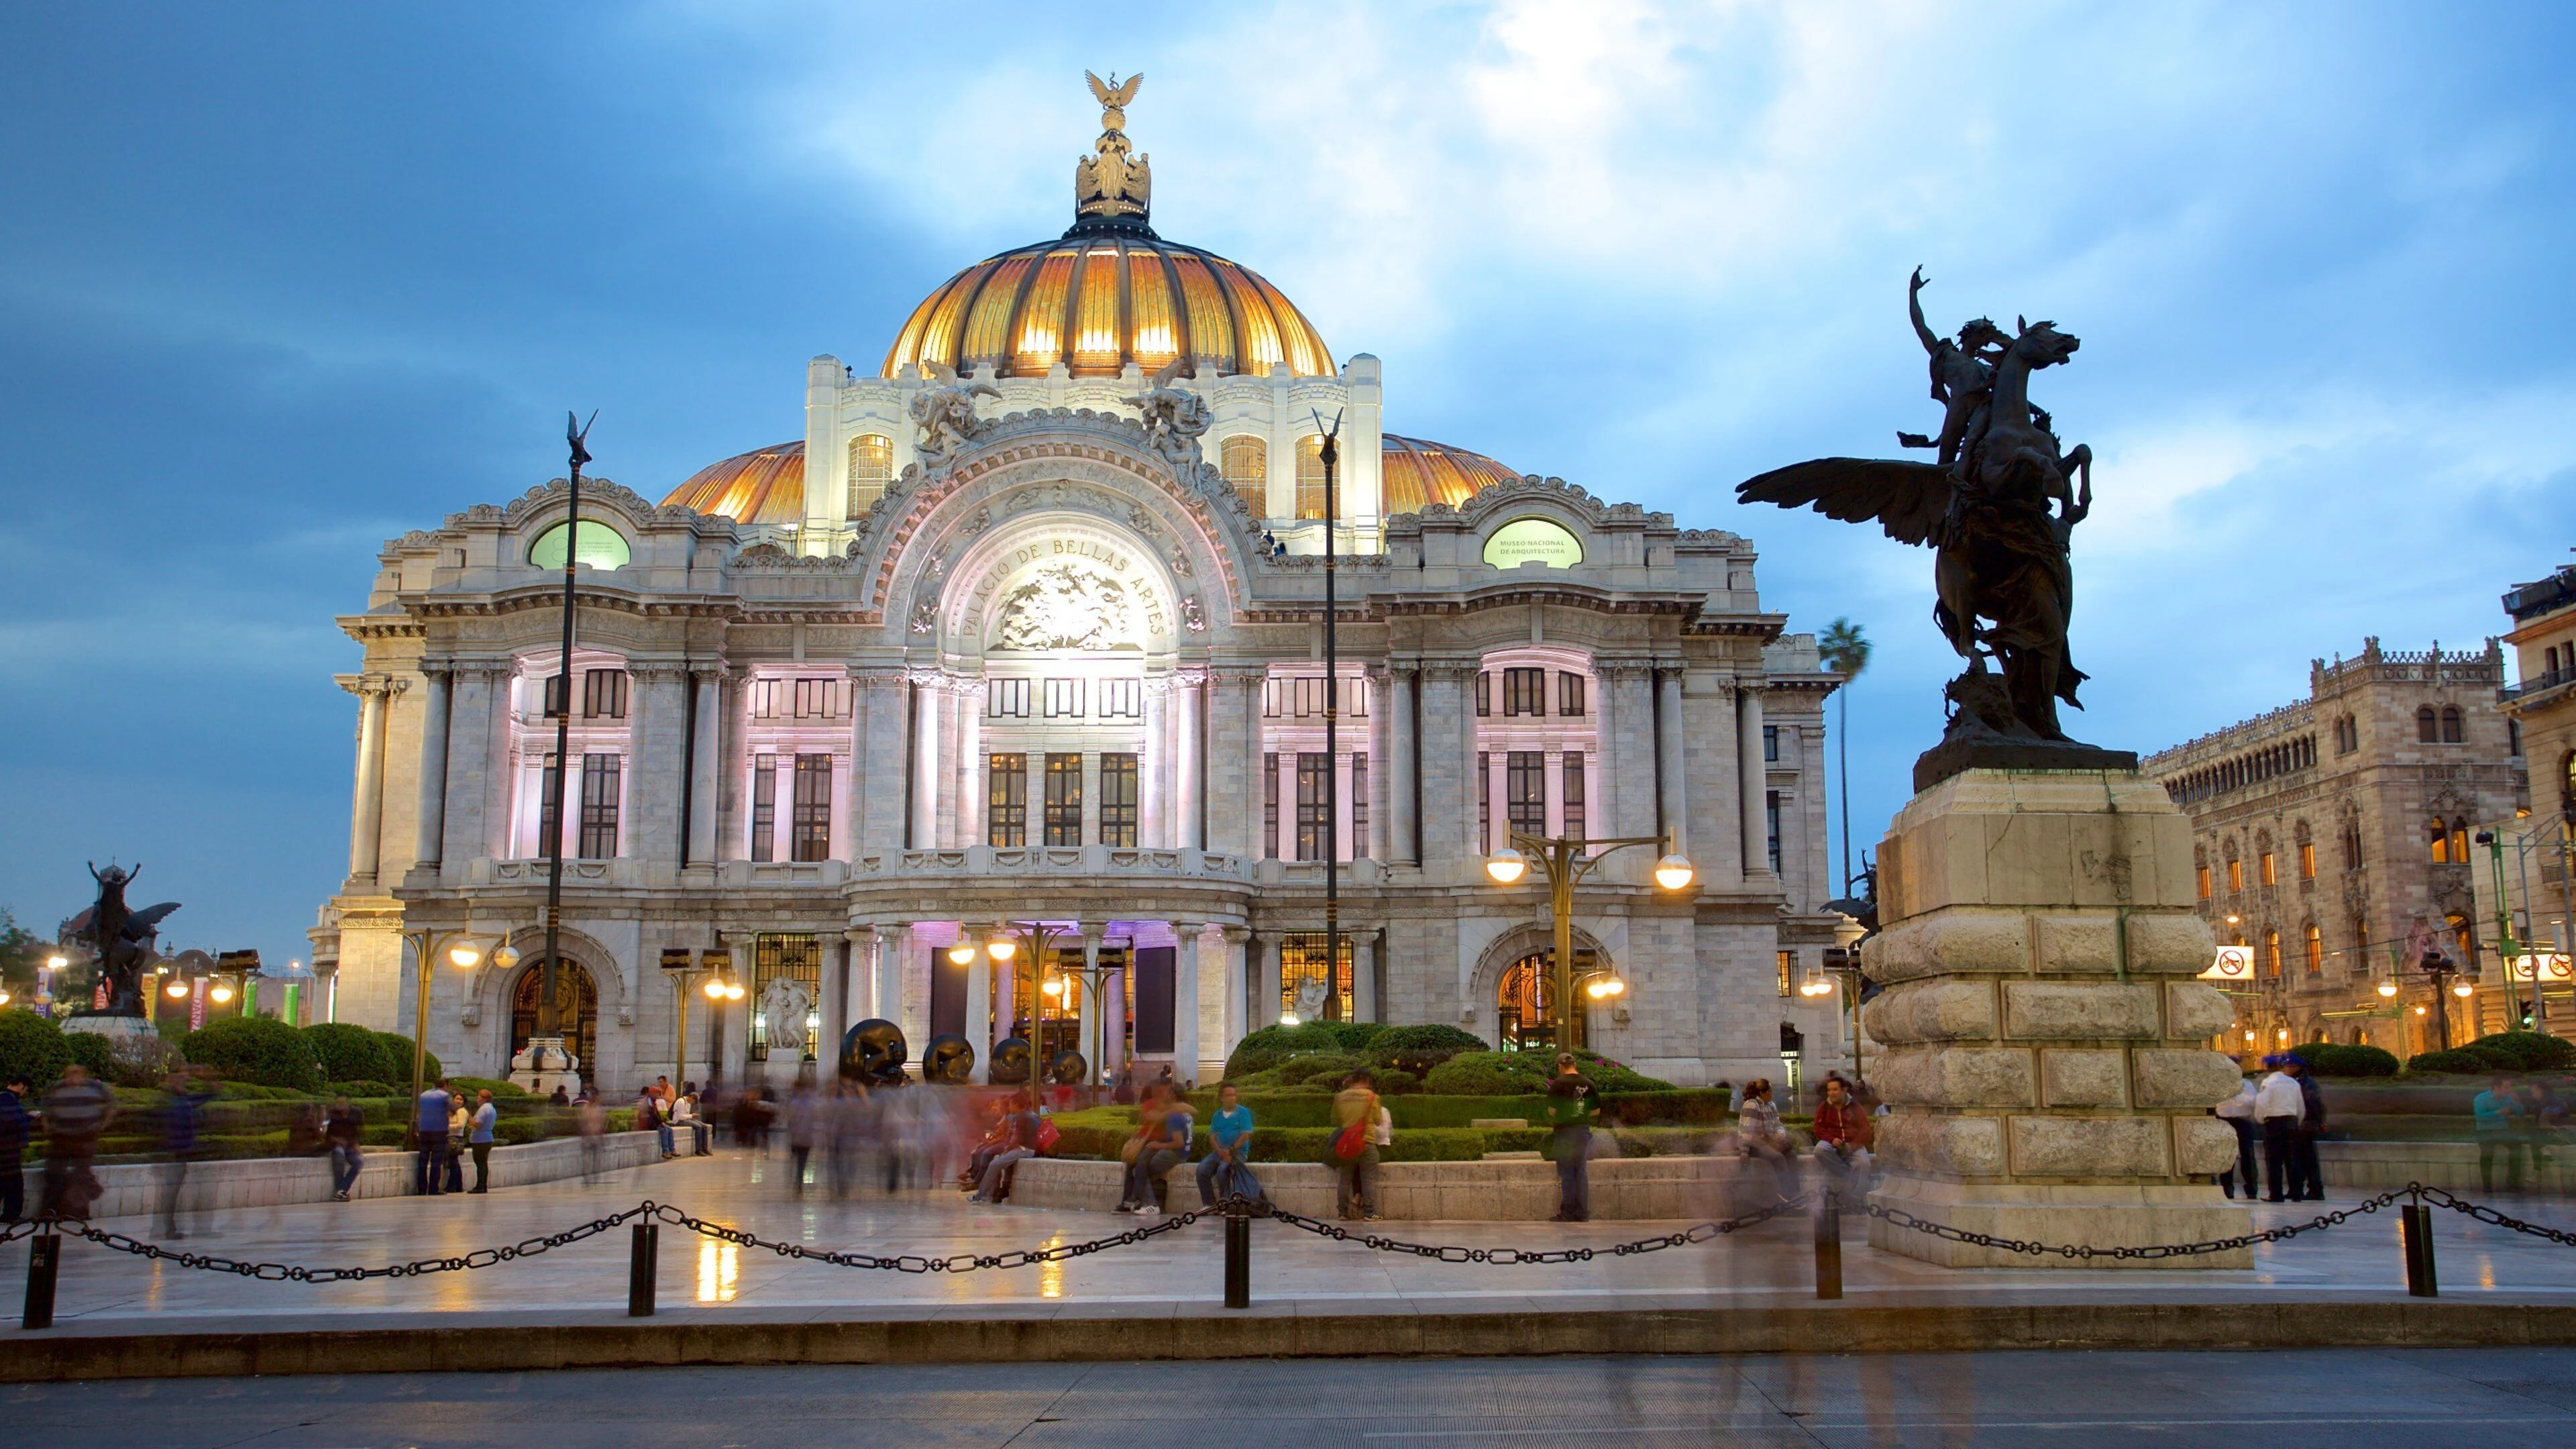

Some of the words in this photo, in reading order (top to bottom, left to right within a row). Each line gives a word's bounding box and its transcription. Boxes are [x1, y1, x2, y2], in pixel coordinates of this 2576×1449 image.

[963, 561, 1011, 637] PALACIO
[1016, 544, 1042, 564] DE
[1053, 539, 1128, 572] BELLAS
[1130, 577, 1164, 635] ARTES
